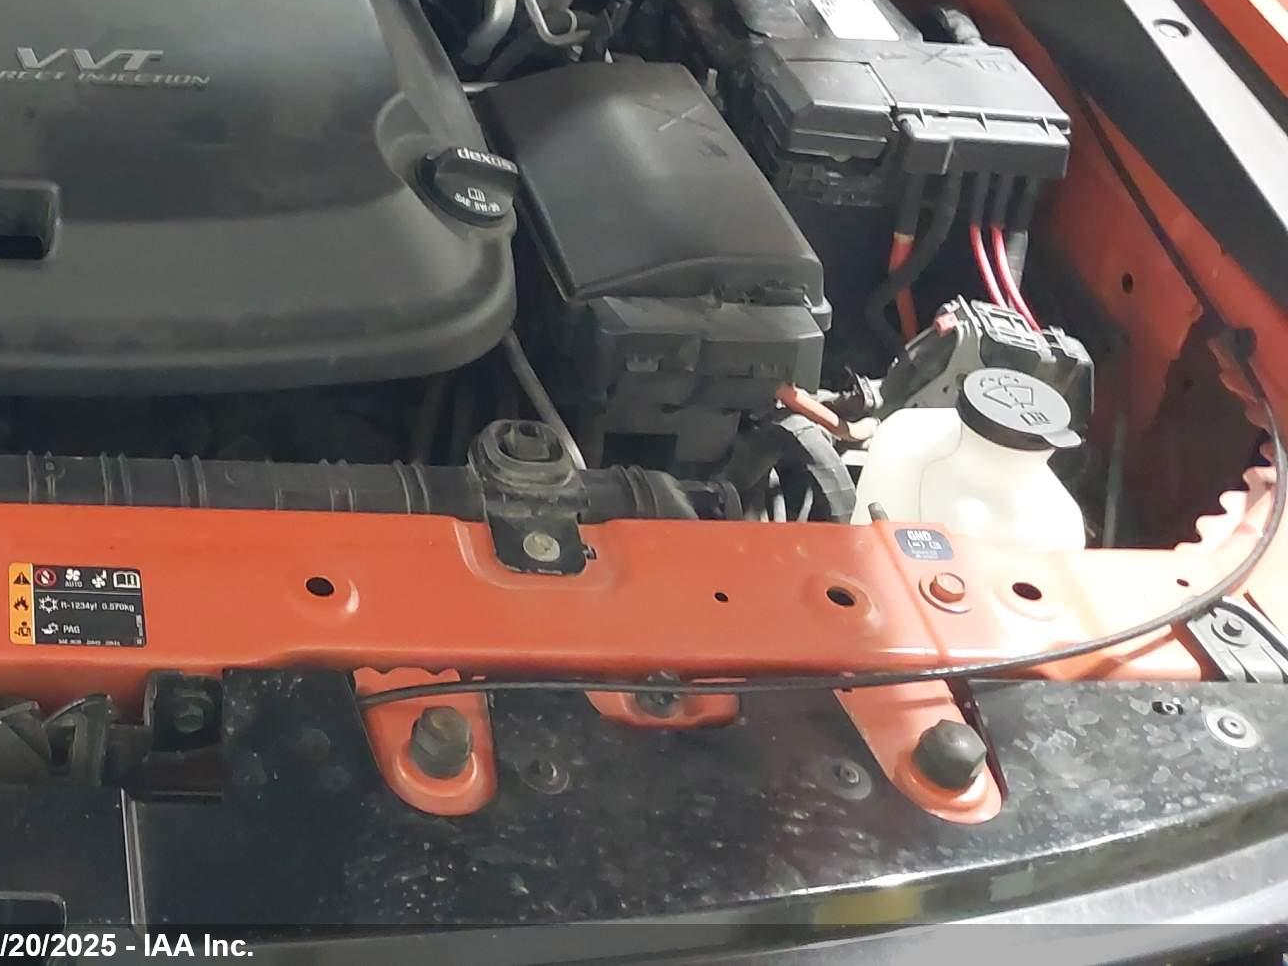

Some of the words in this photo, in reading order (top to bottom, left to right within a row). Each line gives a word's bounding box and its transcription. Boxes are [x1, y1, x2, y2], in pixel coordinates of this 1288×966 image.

[16, 46, 165, 72] VVT
[77, 71, 211, 86] INJECTION
[65, 580, 83, 588] AUTO
[63, 625, 81, 634] PAG
